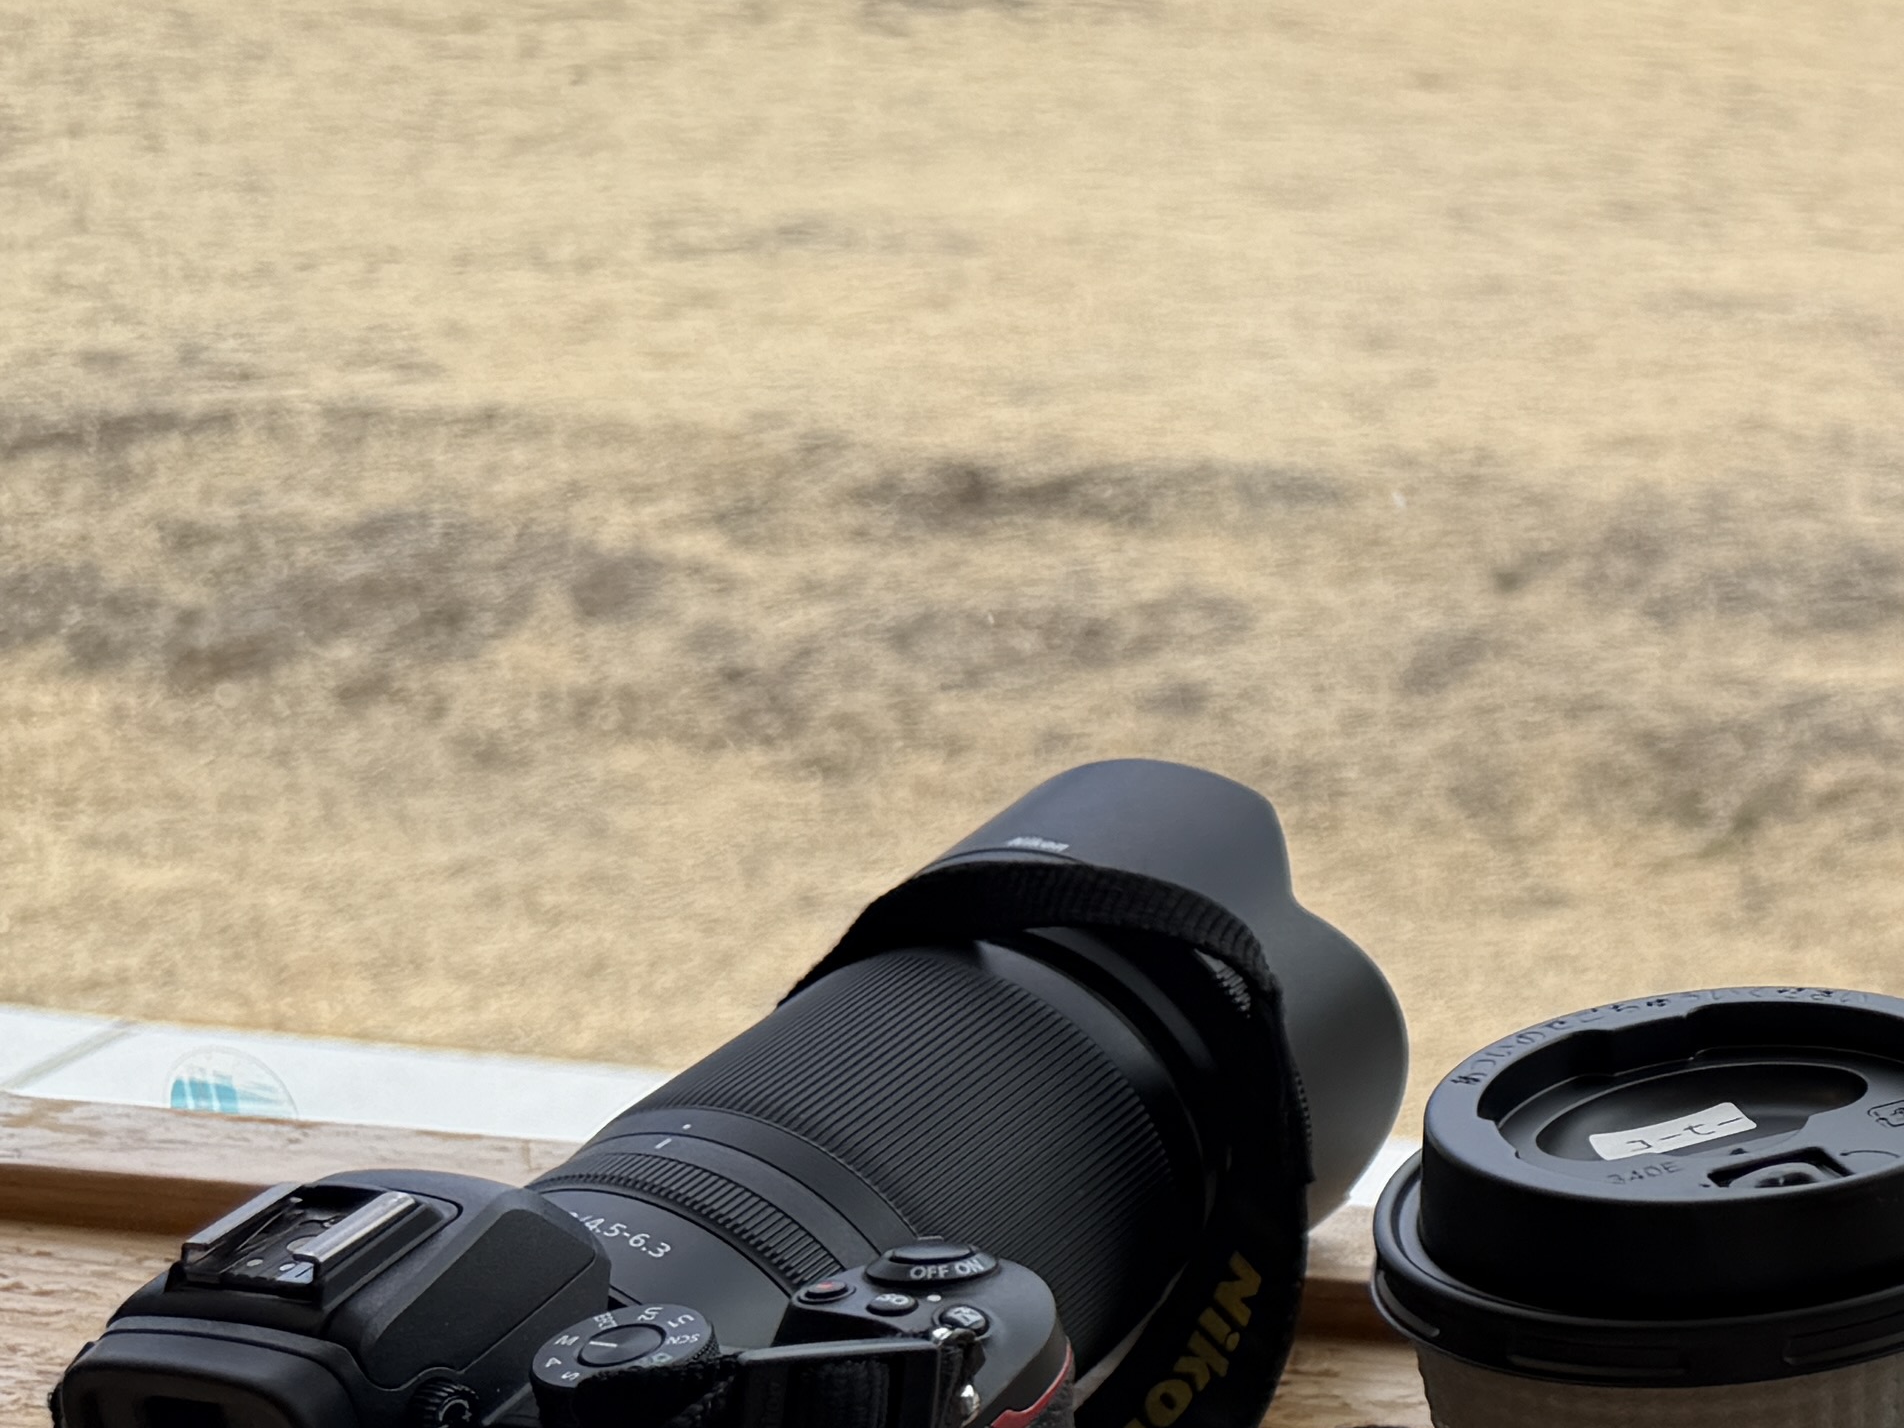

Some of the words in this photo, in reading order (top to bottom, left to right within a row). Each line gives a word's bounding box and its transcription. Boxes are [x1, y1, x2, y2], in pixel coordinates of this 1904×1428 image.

[910, 1264, 950, 1280] OFF
[954, 1258, 985, 1275] ON
[555, 1335, 579, 1346] M
